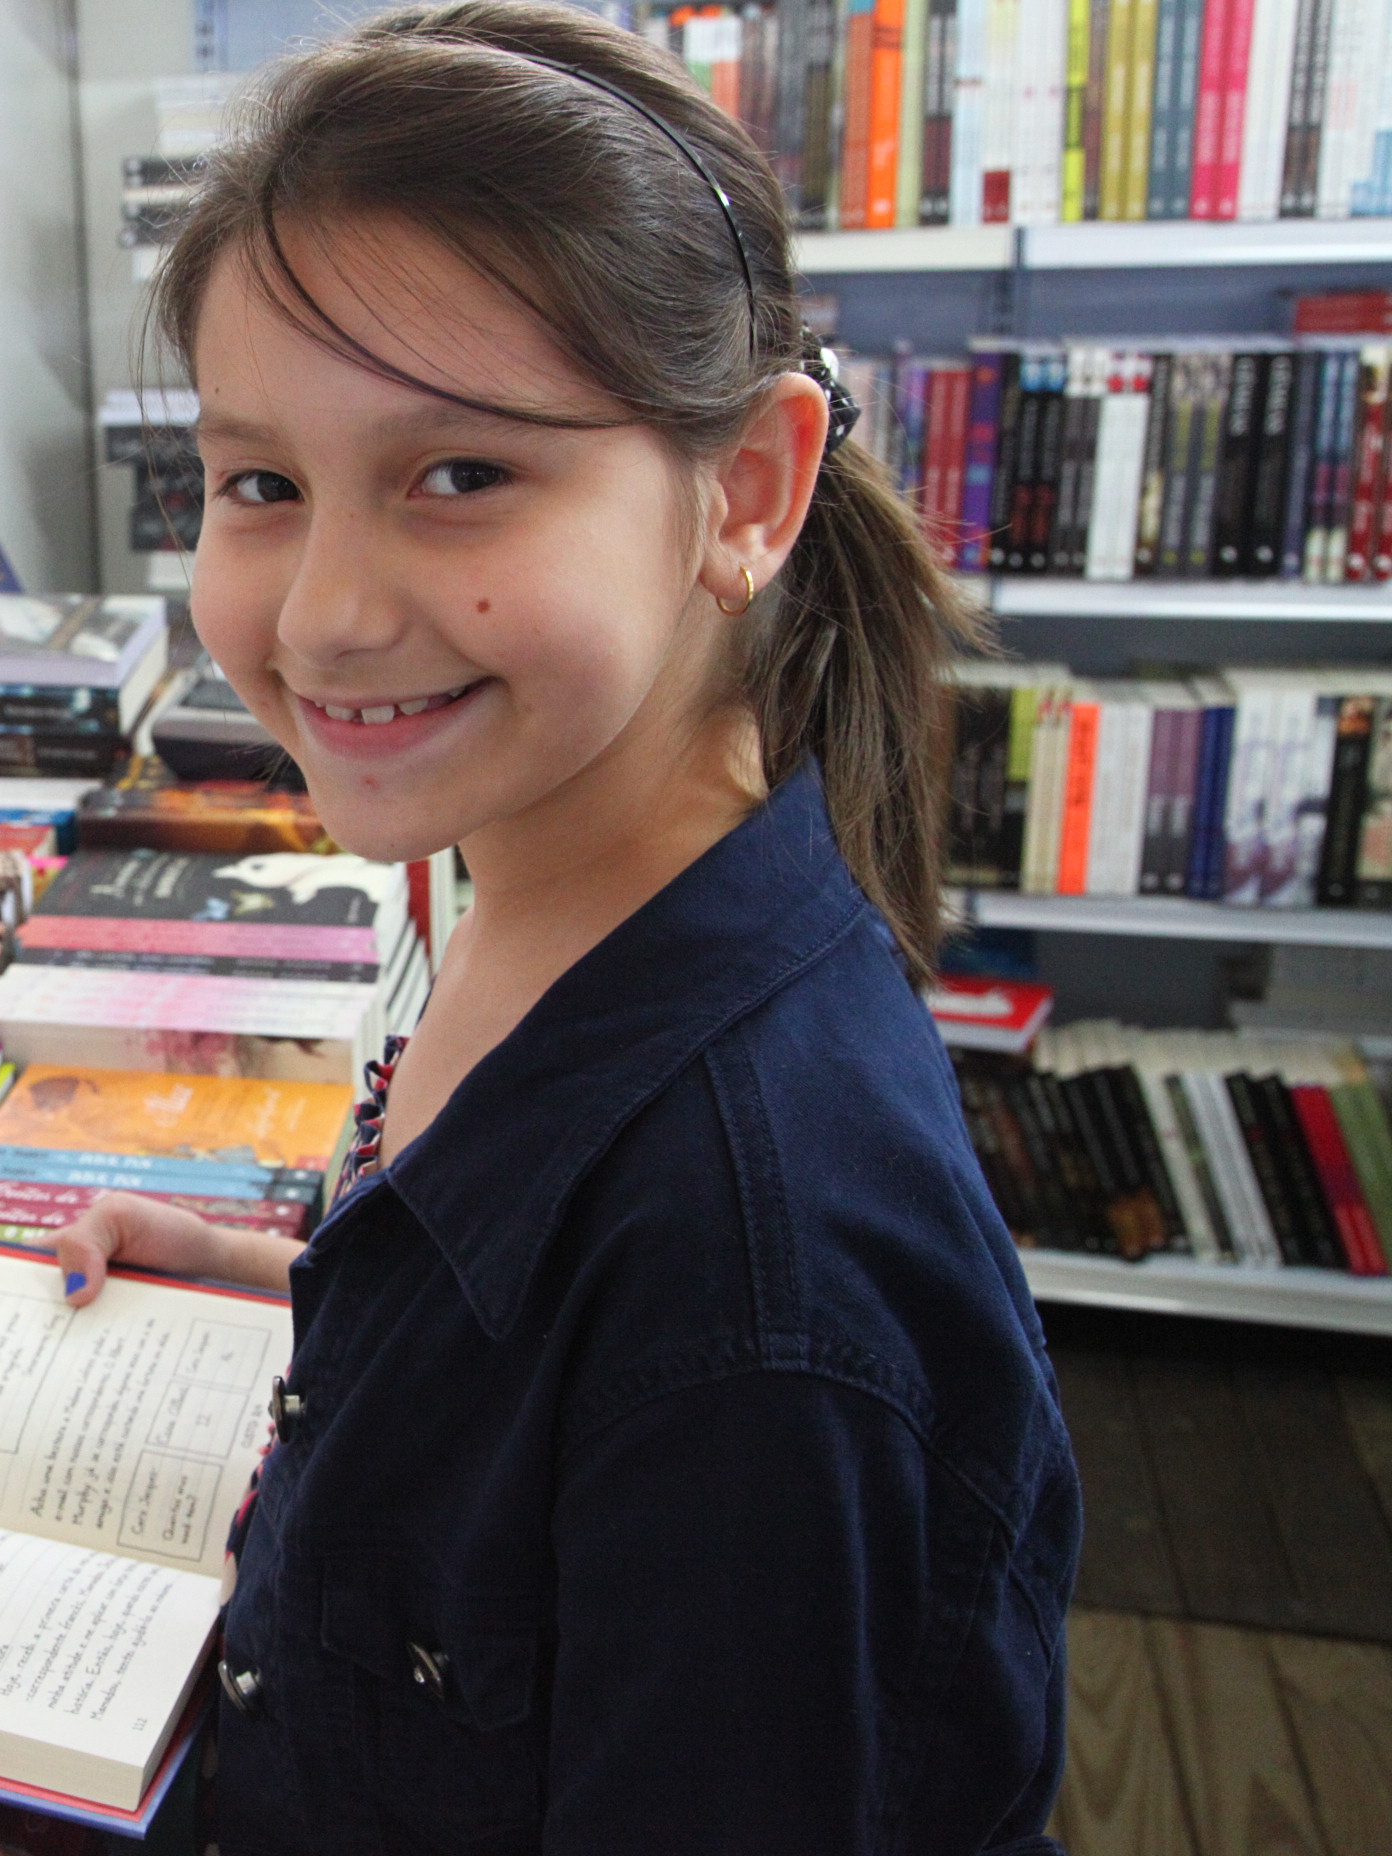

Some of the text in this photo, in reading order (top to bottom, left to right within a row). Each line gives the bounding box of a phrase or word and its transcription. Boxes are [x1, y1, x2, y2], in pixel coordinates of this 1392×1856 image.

[30, 1488, 48, 1518] Acho
[55, 1490, 68, 1522] e-mail
[62, 1484, 98, 1526] Murphy
[96, 1499, 113, 1530] amigo
[131, 1510, 148, 1535] Caro
[162, 1499, 182, 1541] Quantos
[17, 1644, 36, 1669] recebi
[38, 1598, 61, 1630] primeira
[85, 1645, 114, 1676] Então,
[48, 1685, 66, 1709] minha
[63, 1652, 83, 1682] atitude
[90, 1681, 122, 1720] Mamadou,
[132, 1718, 148, 1732] 112
